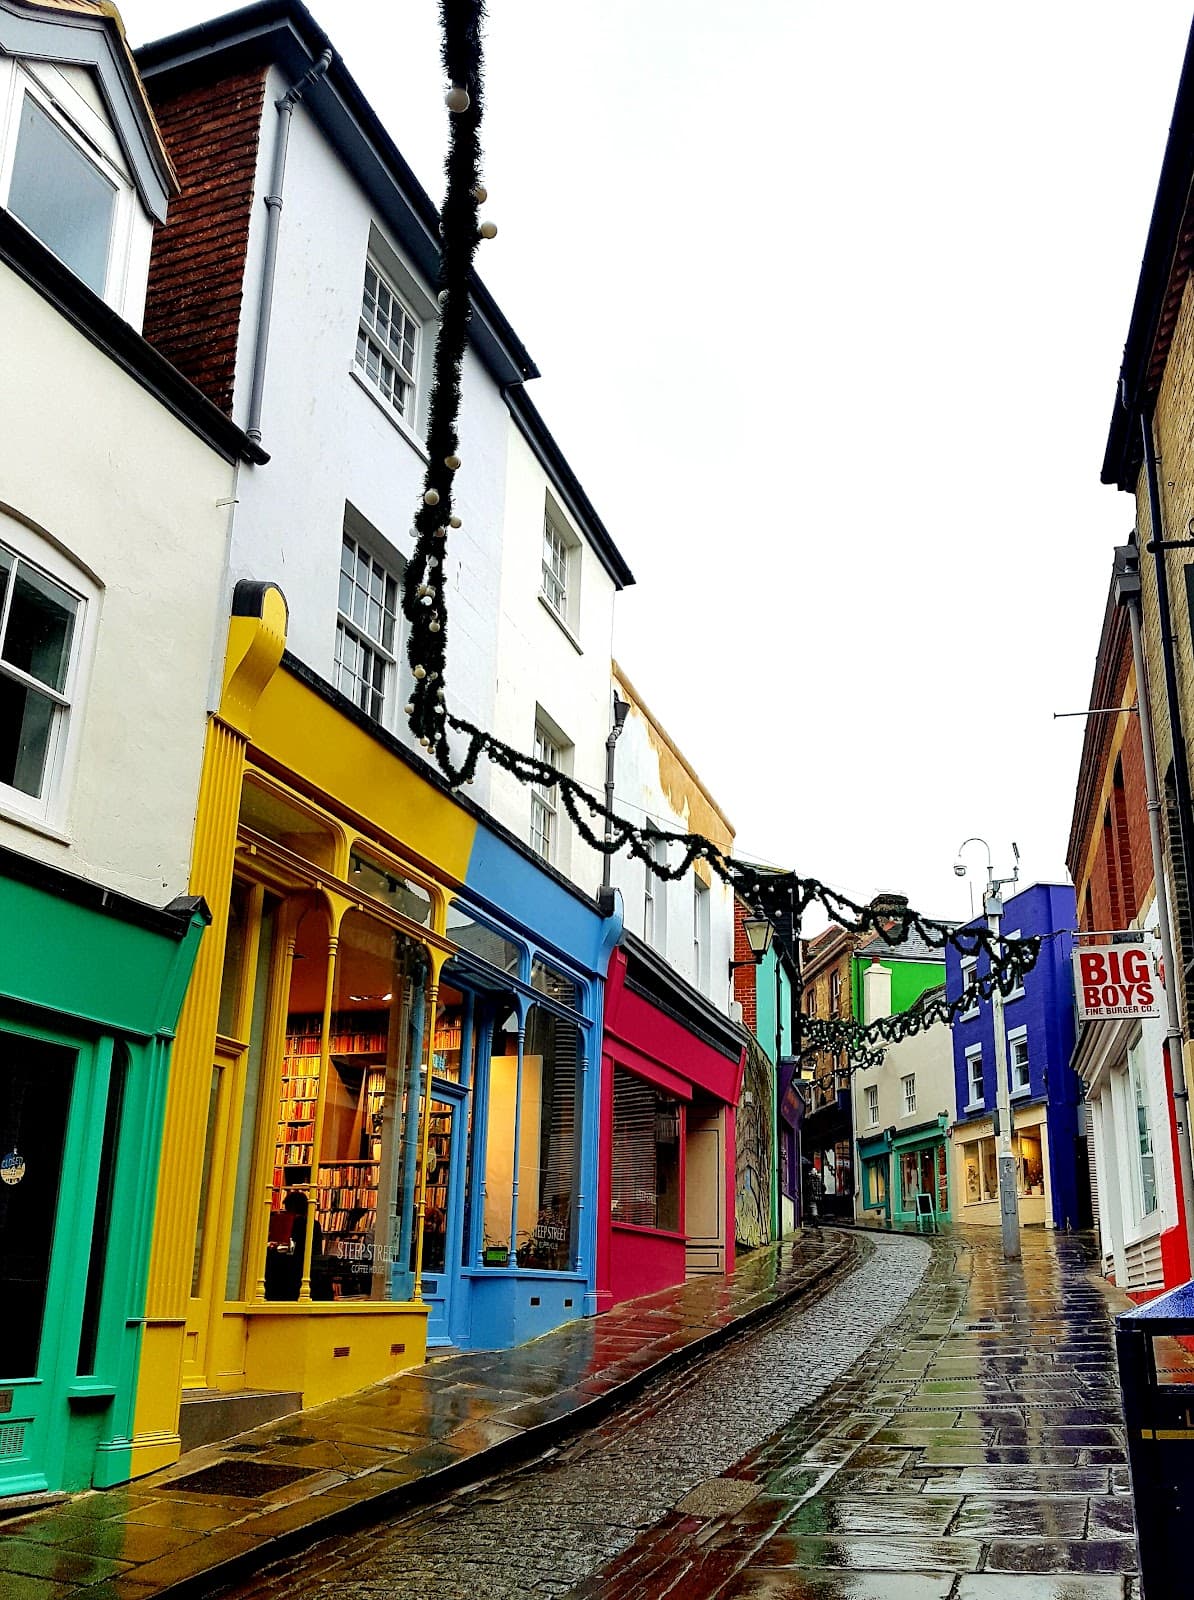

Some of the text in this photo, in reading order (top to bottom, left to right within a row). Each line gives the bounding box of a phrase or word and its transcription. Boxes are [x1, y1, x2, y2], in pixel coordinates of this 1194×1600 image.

[1079, 949, 1151, 986] BIG
[1083, 983, 1155, 1008] BOYS
[1106, 1005, 1139, 1014] BURGER
[548, 1227, 566, 1240] STREET
[336, 1241, 398, 1262] STEEP STREET
